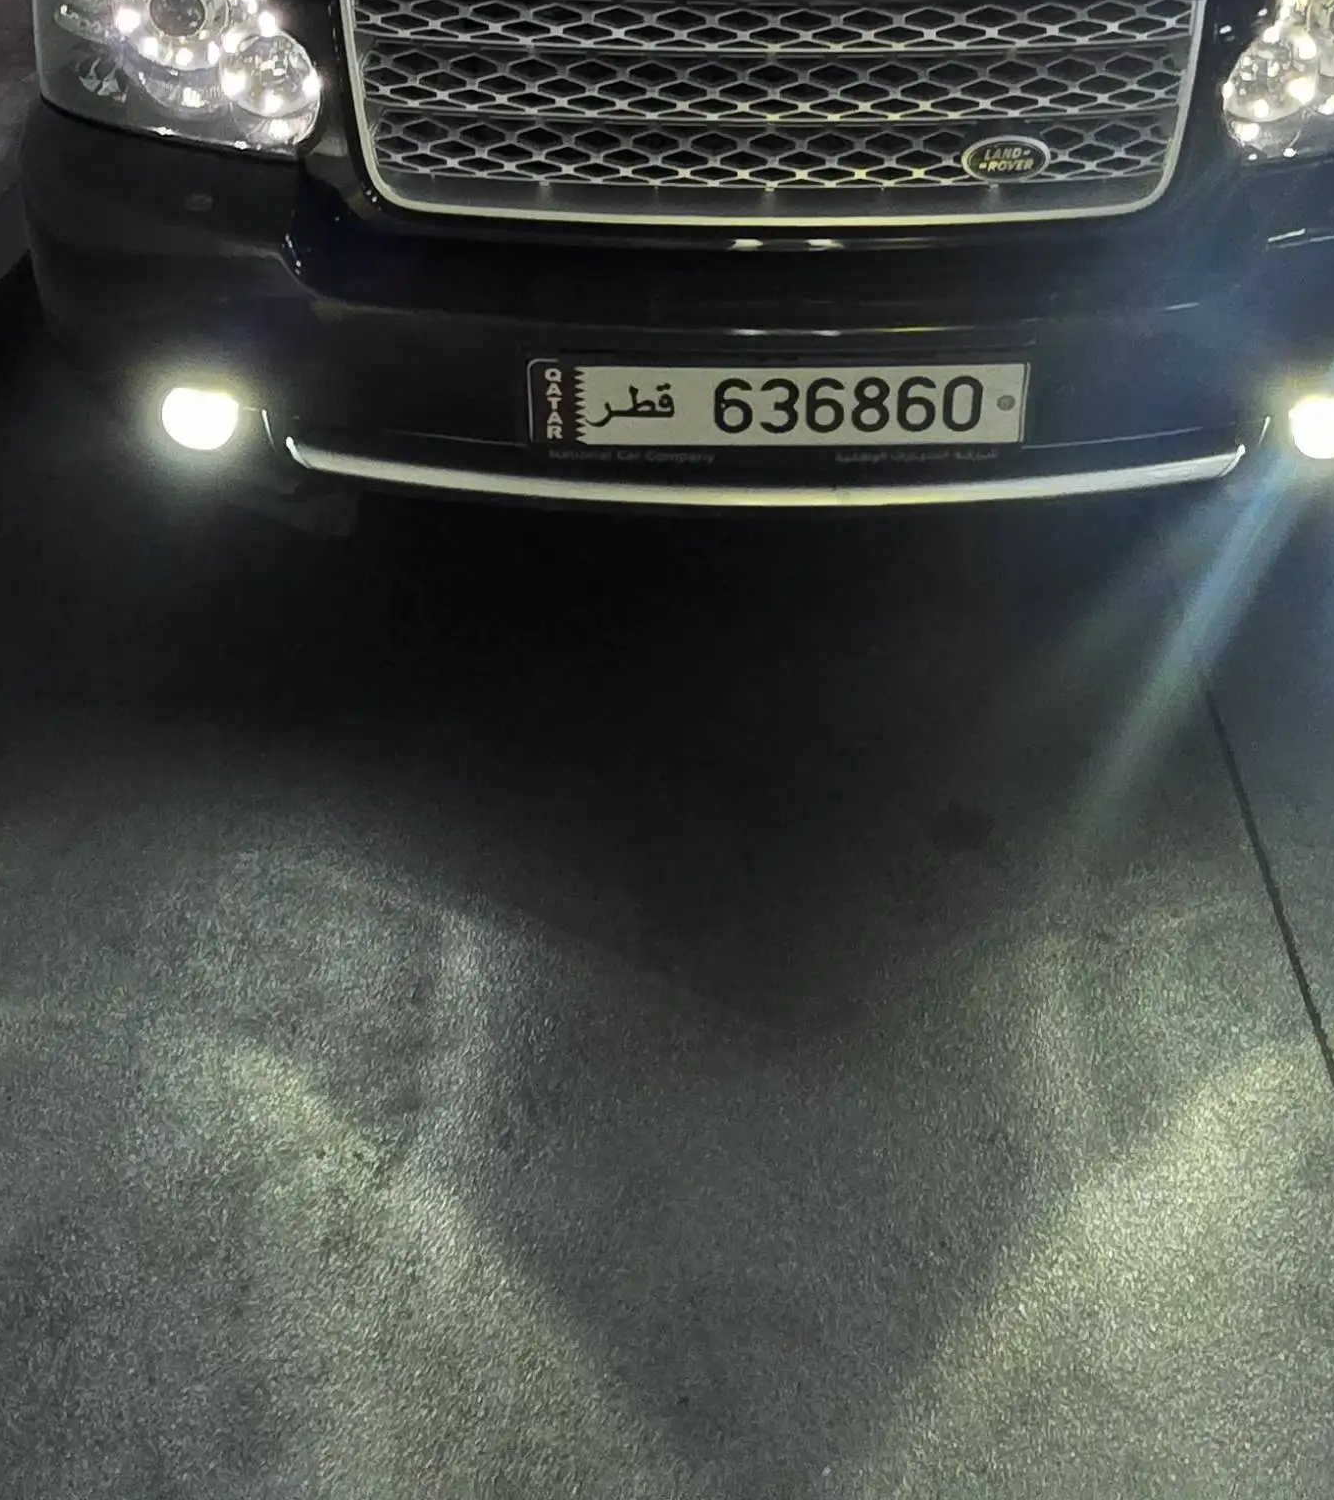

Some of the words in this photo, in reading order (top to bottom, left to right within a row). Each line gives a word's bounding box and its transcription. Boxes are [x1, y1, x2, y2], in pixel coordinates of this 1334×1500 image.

[544, 368, 563, 440] QATAR
[586, 383, 675, 428] قطر
[713, 376, 984, 434] 636860
